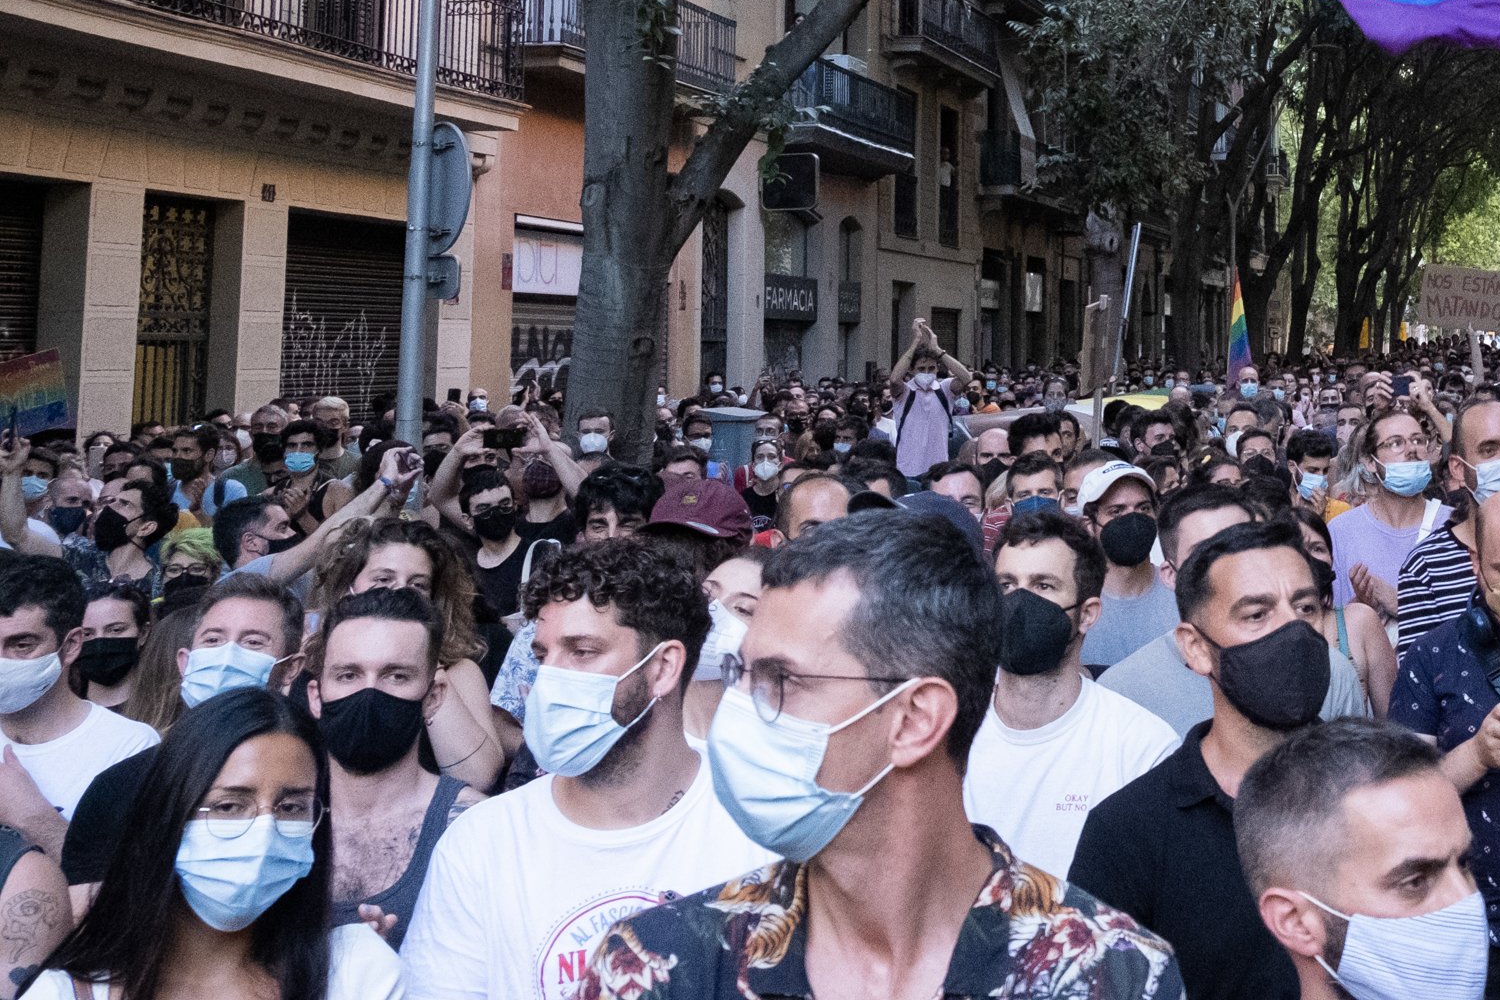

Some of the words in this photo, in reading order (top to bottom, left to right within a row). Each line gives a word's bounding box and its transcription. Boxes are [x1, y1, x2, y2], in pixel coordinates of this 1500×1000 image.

[1426, 273, 1453, 290] NOS
[1065, 794, 1088, 802] OKAY
[1056, 803, 1073, 811] BUT
[1074, 803, 1088, 811] NO
